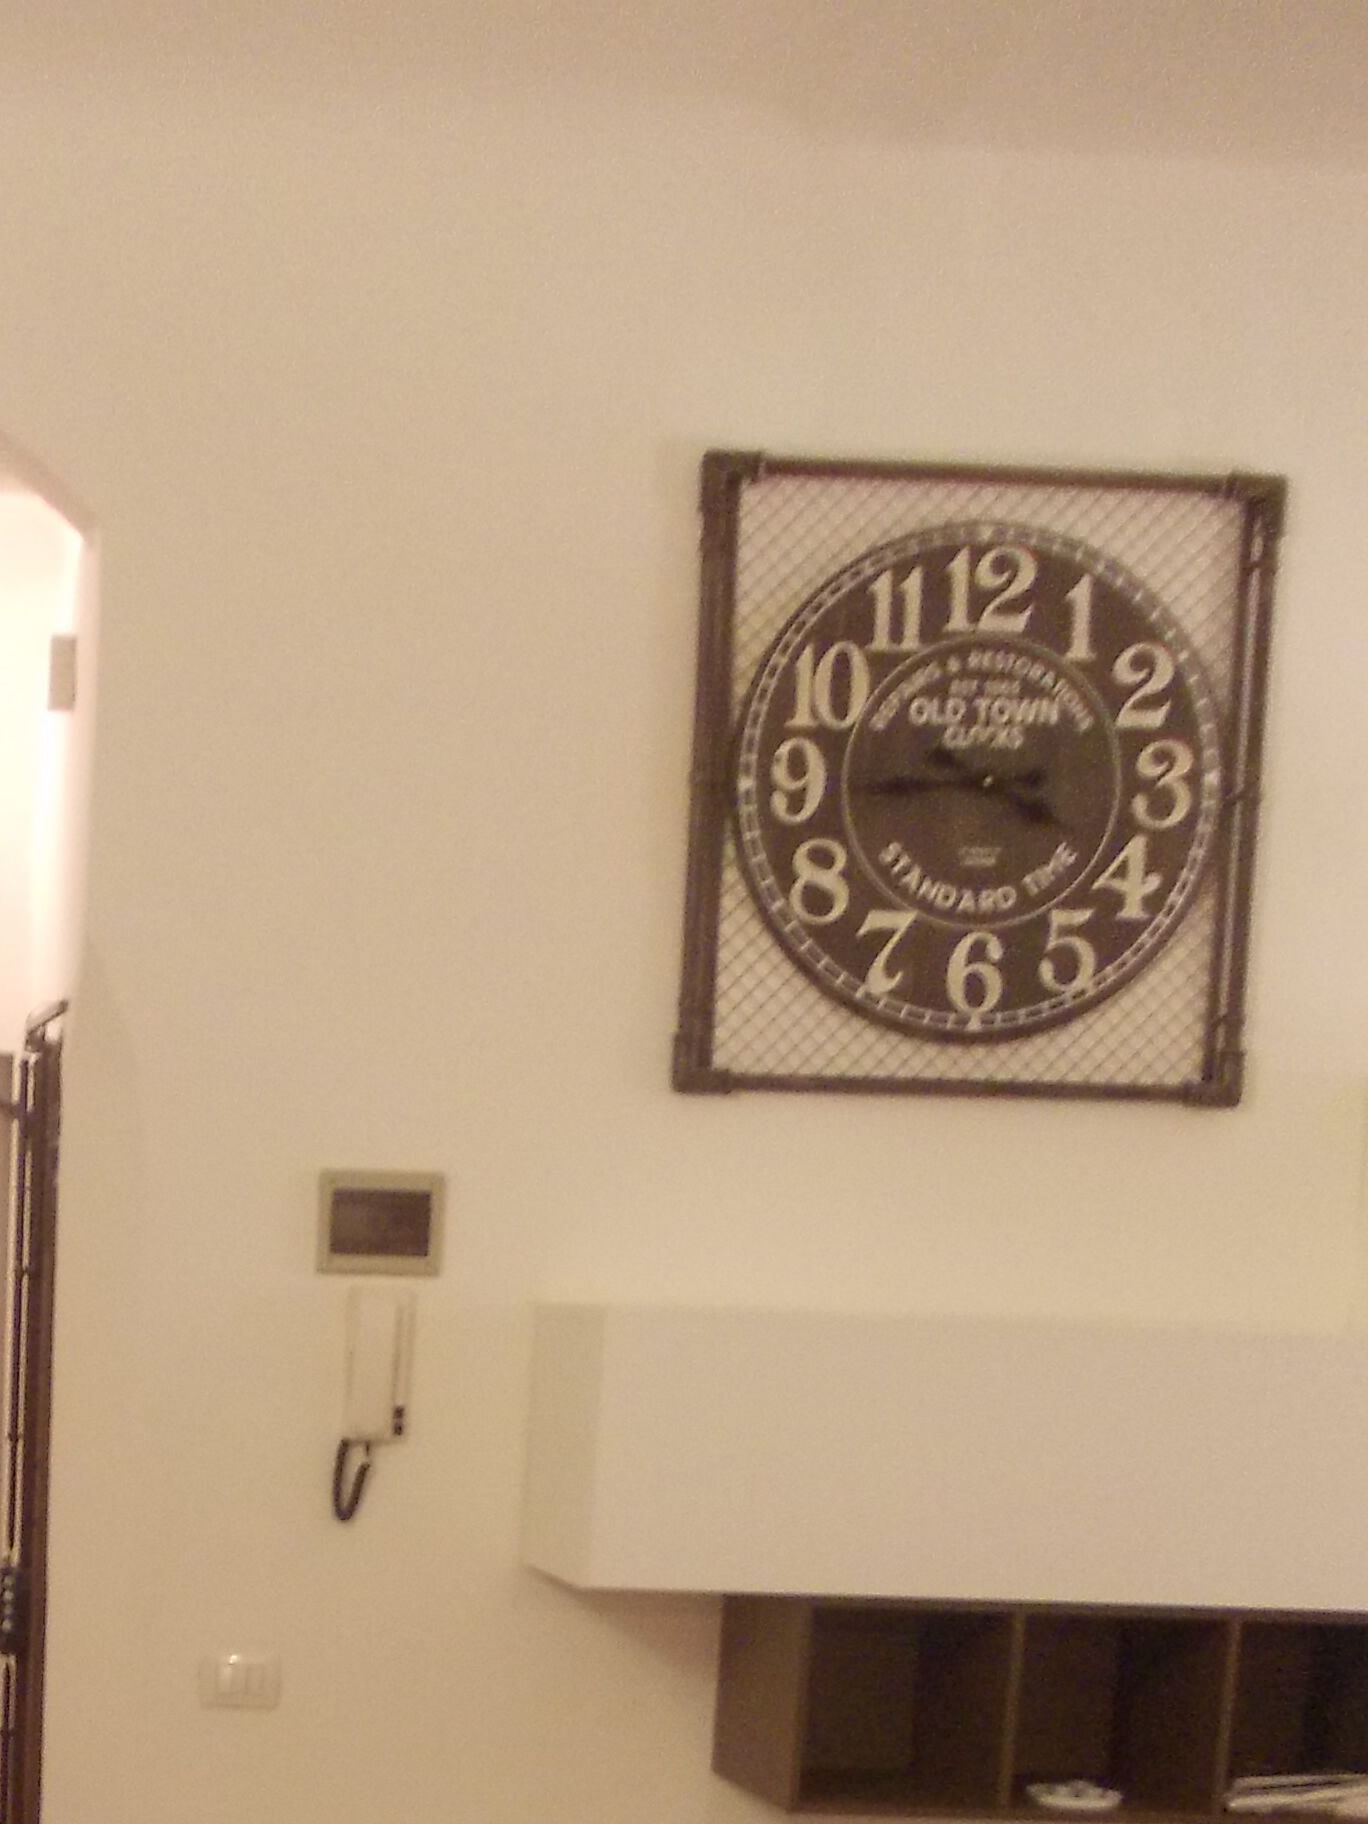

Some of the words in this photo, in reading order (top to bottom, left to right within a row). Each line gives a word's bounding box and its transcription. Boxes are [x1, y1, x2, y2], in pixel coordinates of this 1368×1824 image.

[869, 566, 924, 652] 11
[943, 547, 1037, 634] 12
[1065, 574, 1098, 661] 1
[785, 641, 870, 730] 10
[909, 697, 967, 726] OLD
[973, 696, 1059, 726] TOWN
[1111, 642, 1175, 728] 2
[770, 739, 827, 825] 9
[1132, 739, 1193, 828] 3
[789, 839, 850, 924] 8
[879, 841, 1017, 914] STANDARD
[1092, 834, 1160, 920] 4
[856, 909, 920, 997] 7
[946, 931, 1003, 1013] 6
[1039, 908, 1096, 994] 5
